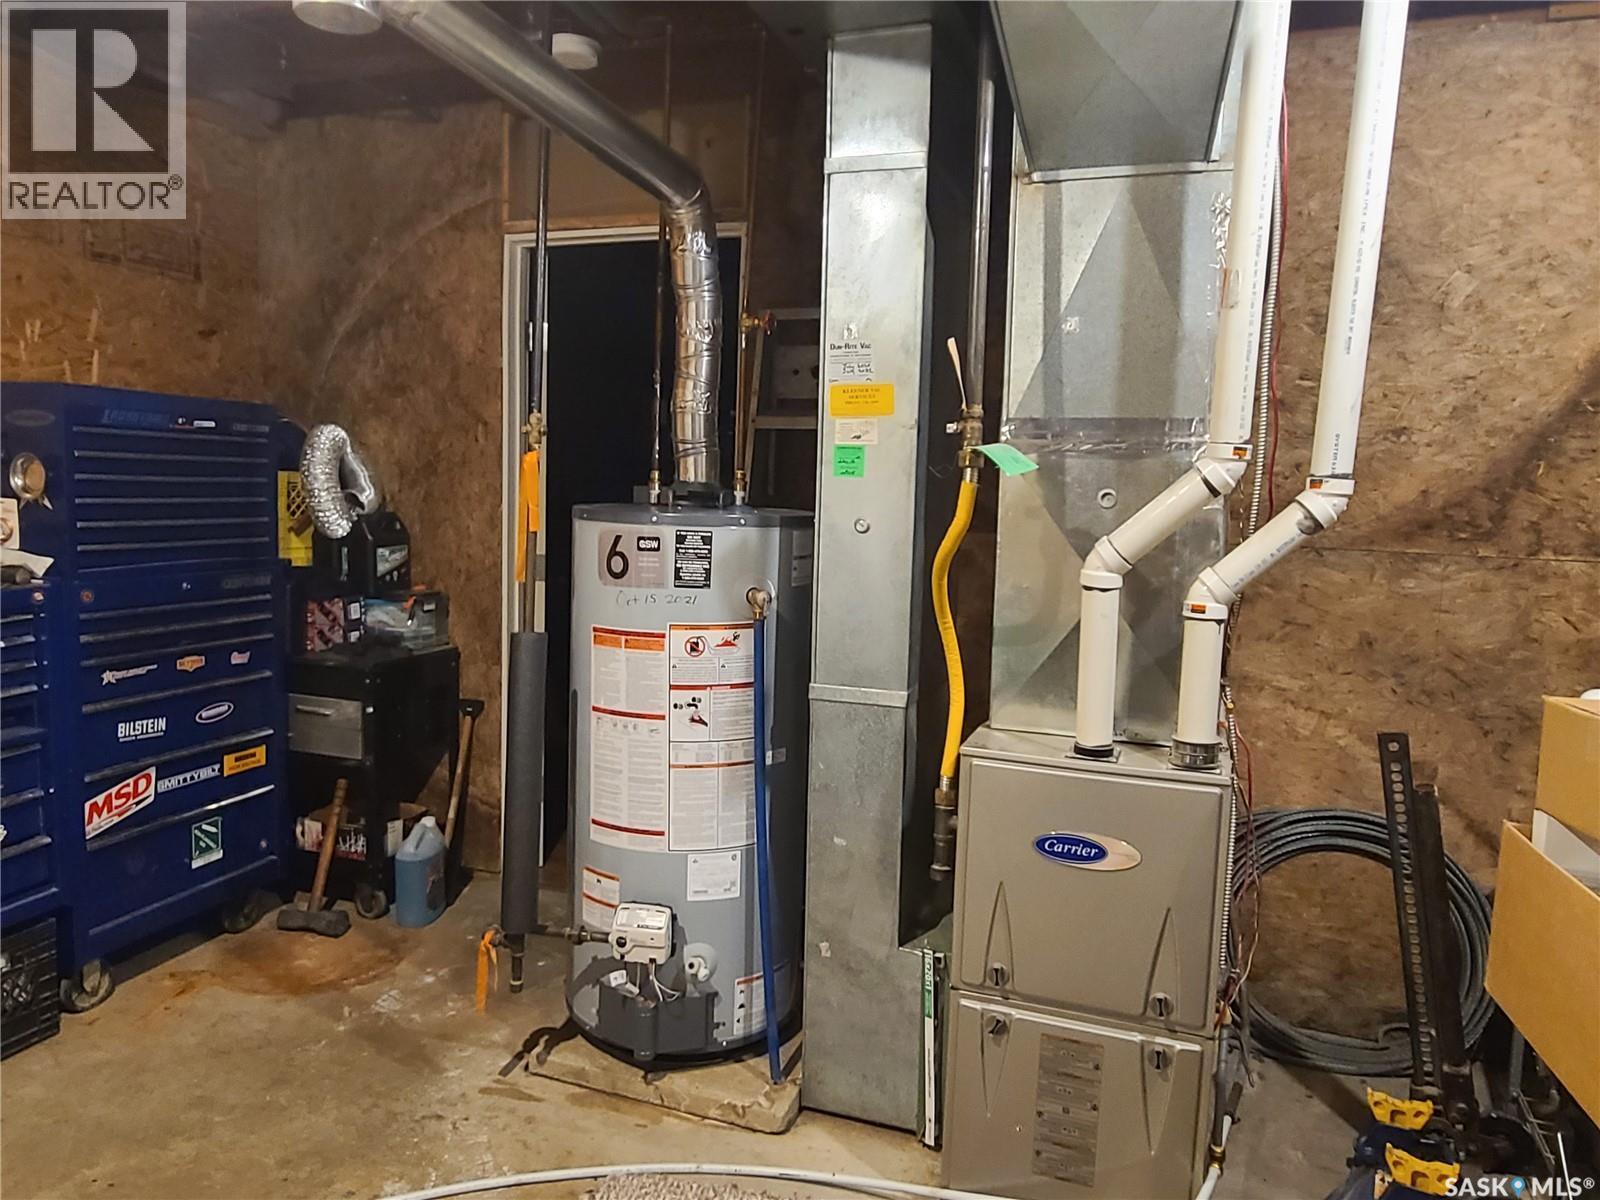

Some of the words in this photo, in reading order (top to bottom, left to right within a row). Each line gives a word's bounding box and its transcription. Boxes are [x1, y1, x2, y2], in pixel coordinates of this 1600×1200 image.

[639, 540, 659, 549] GSW
[606, 534, 629, 580] 6
[118, 717, 166, 738] BILSTEIN
[87, 772, 153, 827] MSD
[1044, 839, 1099, 858] Carrier
